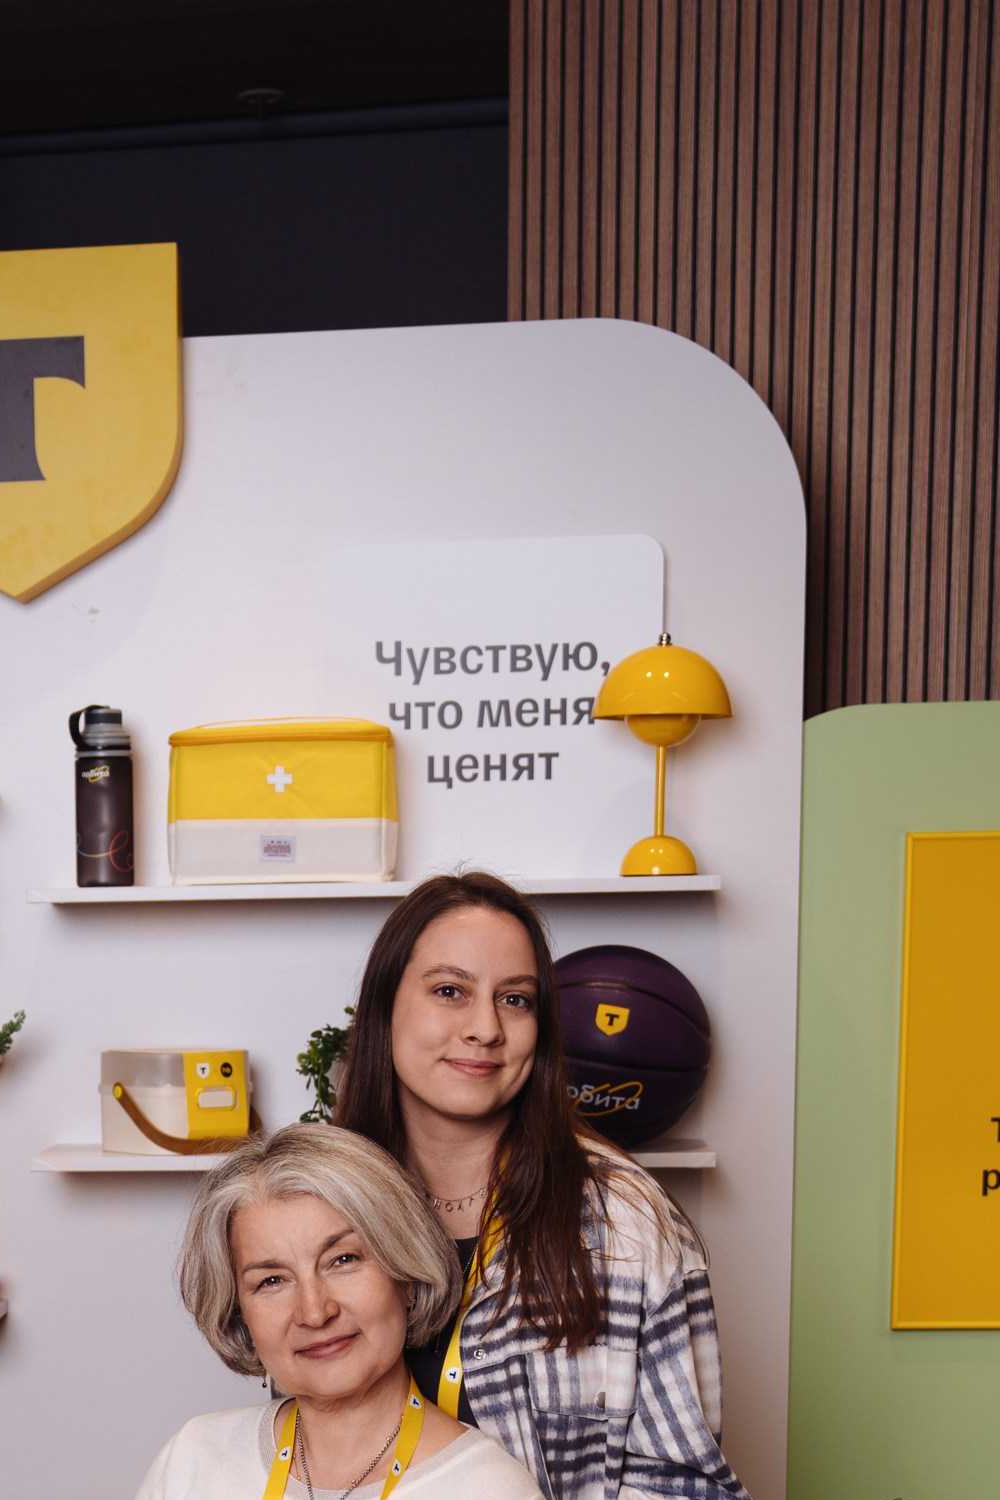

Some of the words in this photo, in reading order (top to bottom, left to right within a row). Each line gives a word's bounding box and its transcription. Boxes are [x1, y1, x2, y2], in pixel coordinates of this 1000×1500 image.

[376, 640, 611, 685] Чувствую,
[388, 700, 463, 731] что
[477, 696, 595, 728] меня
[427, 752, 560, 789] ценят
